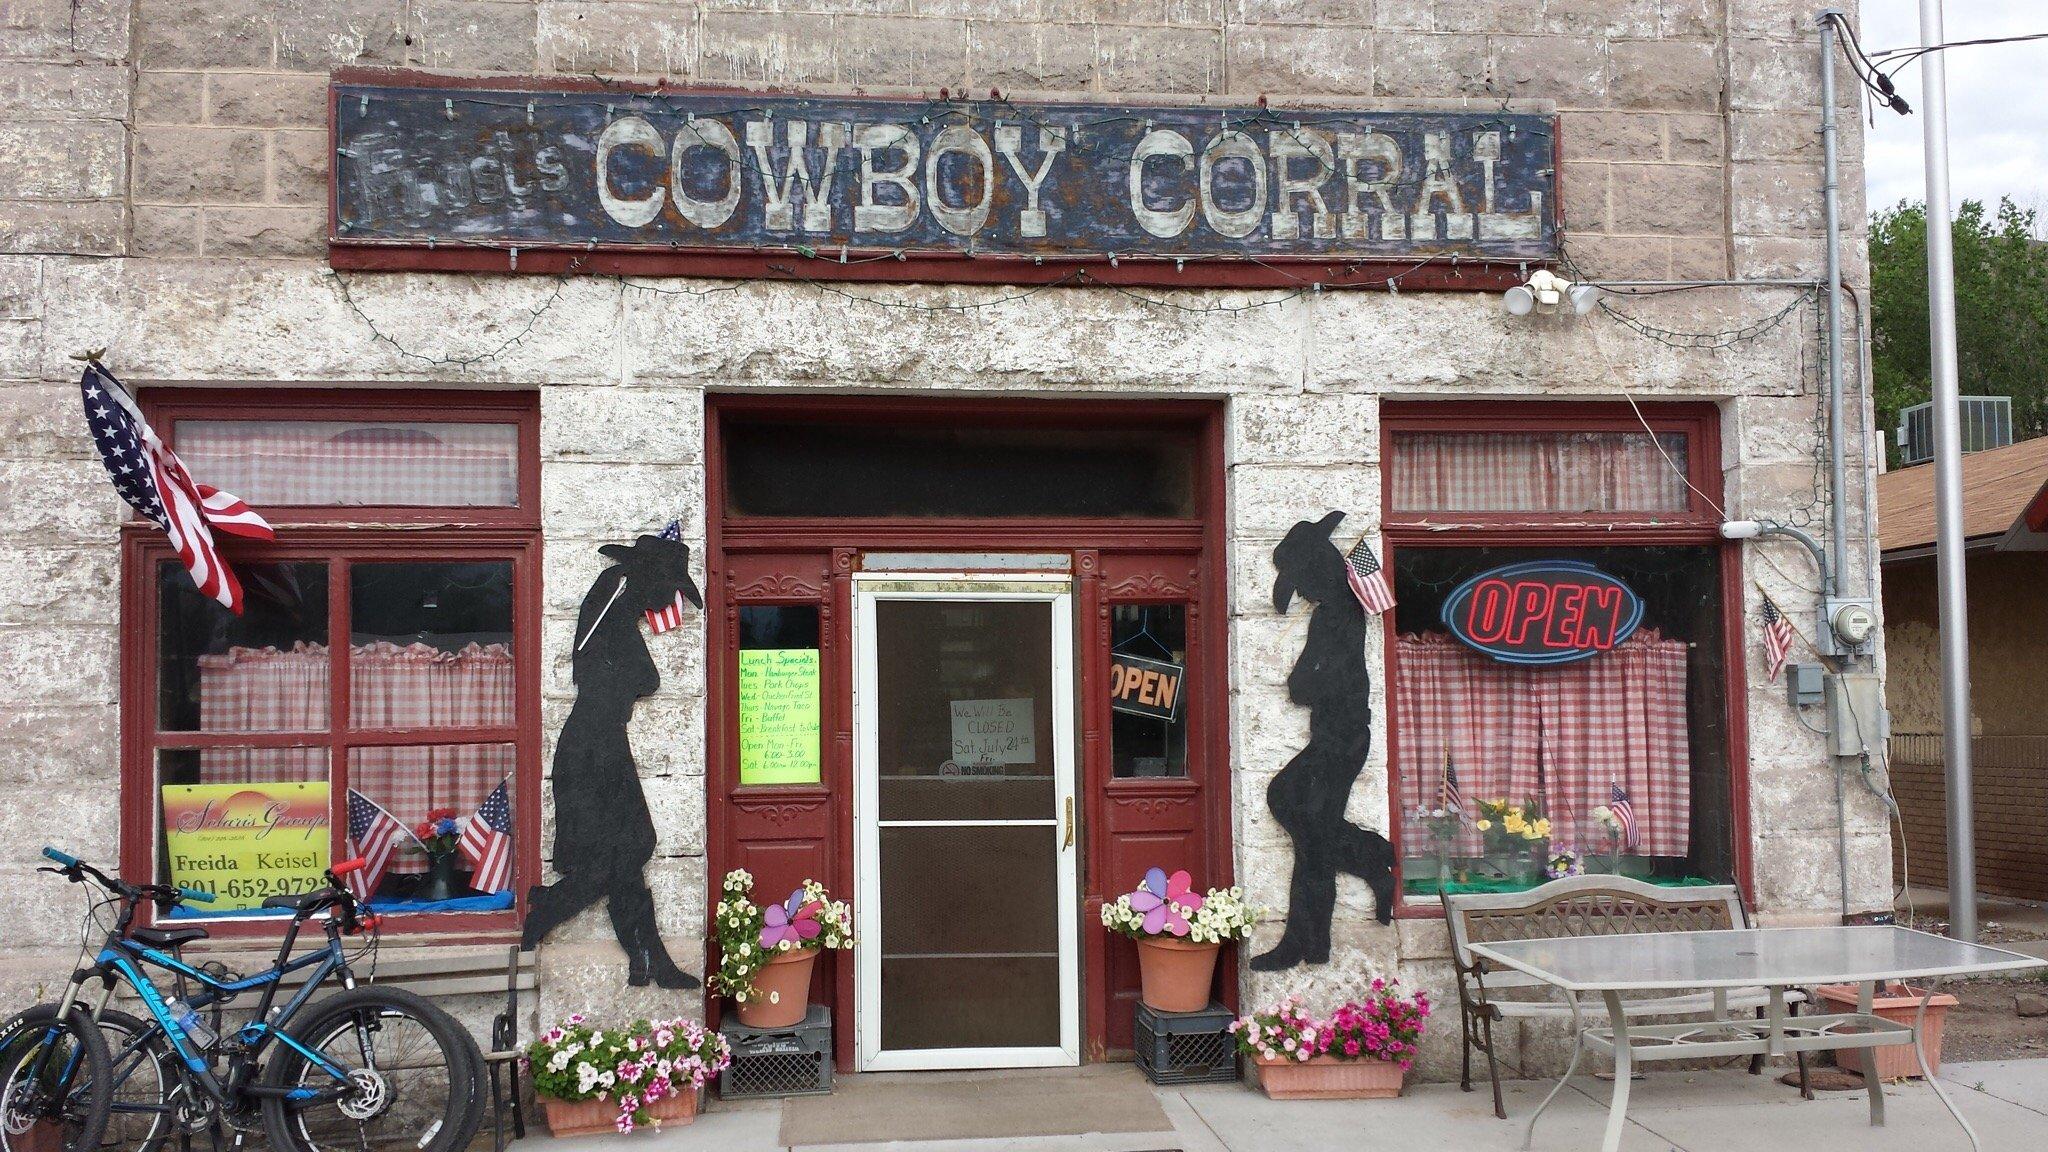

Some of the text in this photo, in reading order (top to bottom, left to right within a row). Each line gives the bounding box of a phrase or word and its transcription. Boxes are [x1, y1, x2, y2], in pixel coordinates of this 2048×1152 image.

[597, 116, 1066, 238] COWBOY
[1129, 129, 1542, 240] CORRAL
[1468, 579, 1622, 649] OPEN
[740, 652, 772, 666] Lunch
[1111, 664, 1177, 709] OPEN
[954, 704, 972, 717] We
[967, 720, 1015, 734] CLOSED
[954, 739, 975, 755] Sat
[978, 738, 1006, 755] July
[961, 765, 1004, 776] NO SMOKING
[175, 852, 318, 871] Freida Keisel
[139, 978, 186, 1041] GIANT
